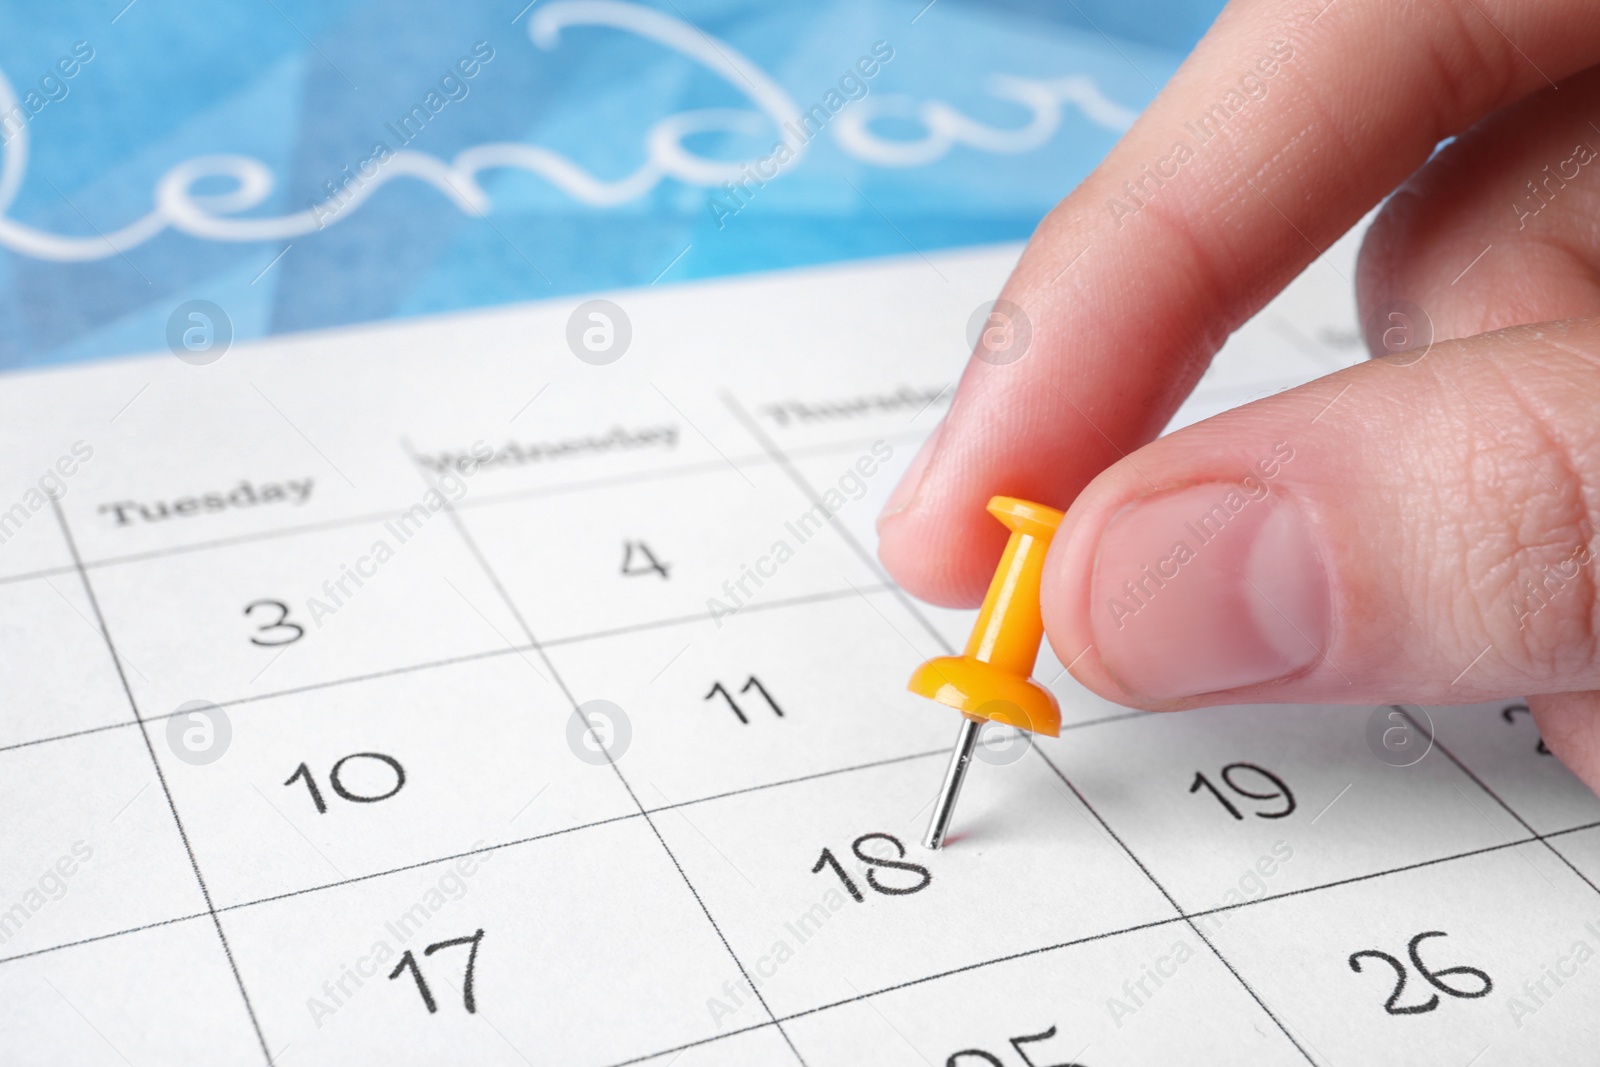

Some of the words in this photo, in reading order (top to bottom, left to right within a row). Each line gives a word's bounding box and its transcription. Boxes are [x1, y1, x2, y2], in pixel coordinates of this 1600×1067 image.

[98, 479, 314, 527] Tuesday
[620, 541, 670, 580] 4
[243, 599, 305, 648] 3
[705, 675, 785, 725] 11
[284, 752, 406, 814] 10
[1189, 761, 1296, 820] 19
[812, 832, 932, 903] 18
[388, 928, 486, 1015] 17
[1348, 930, 1493, 1016] 26
